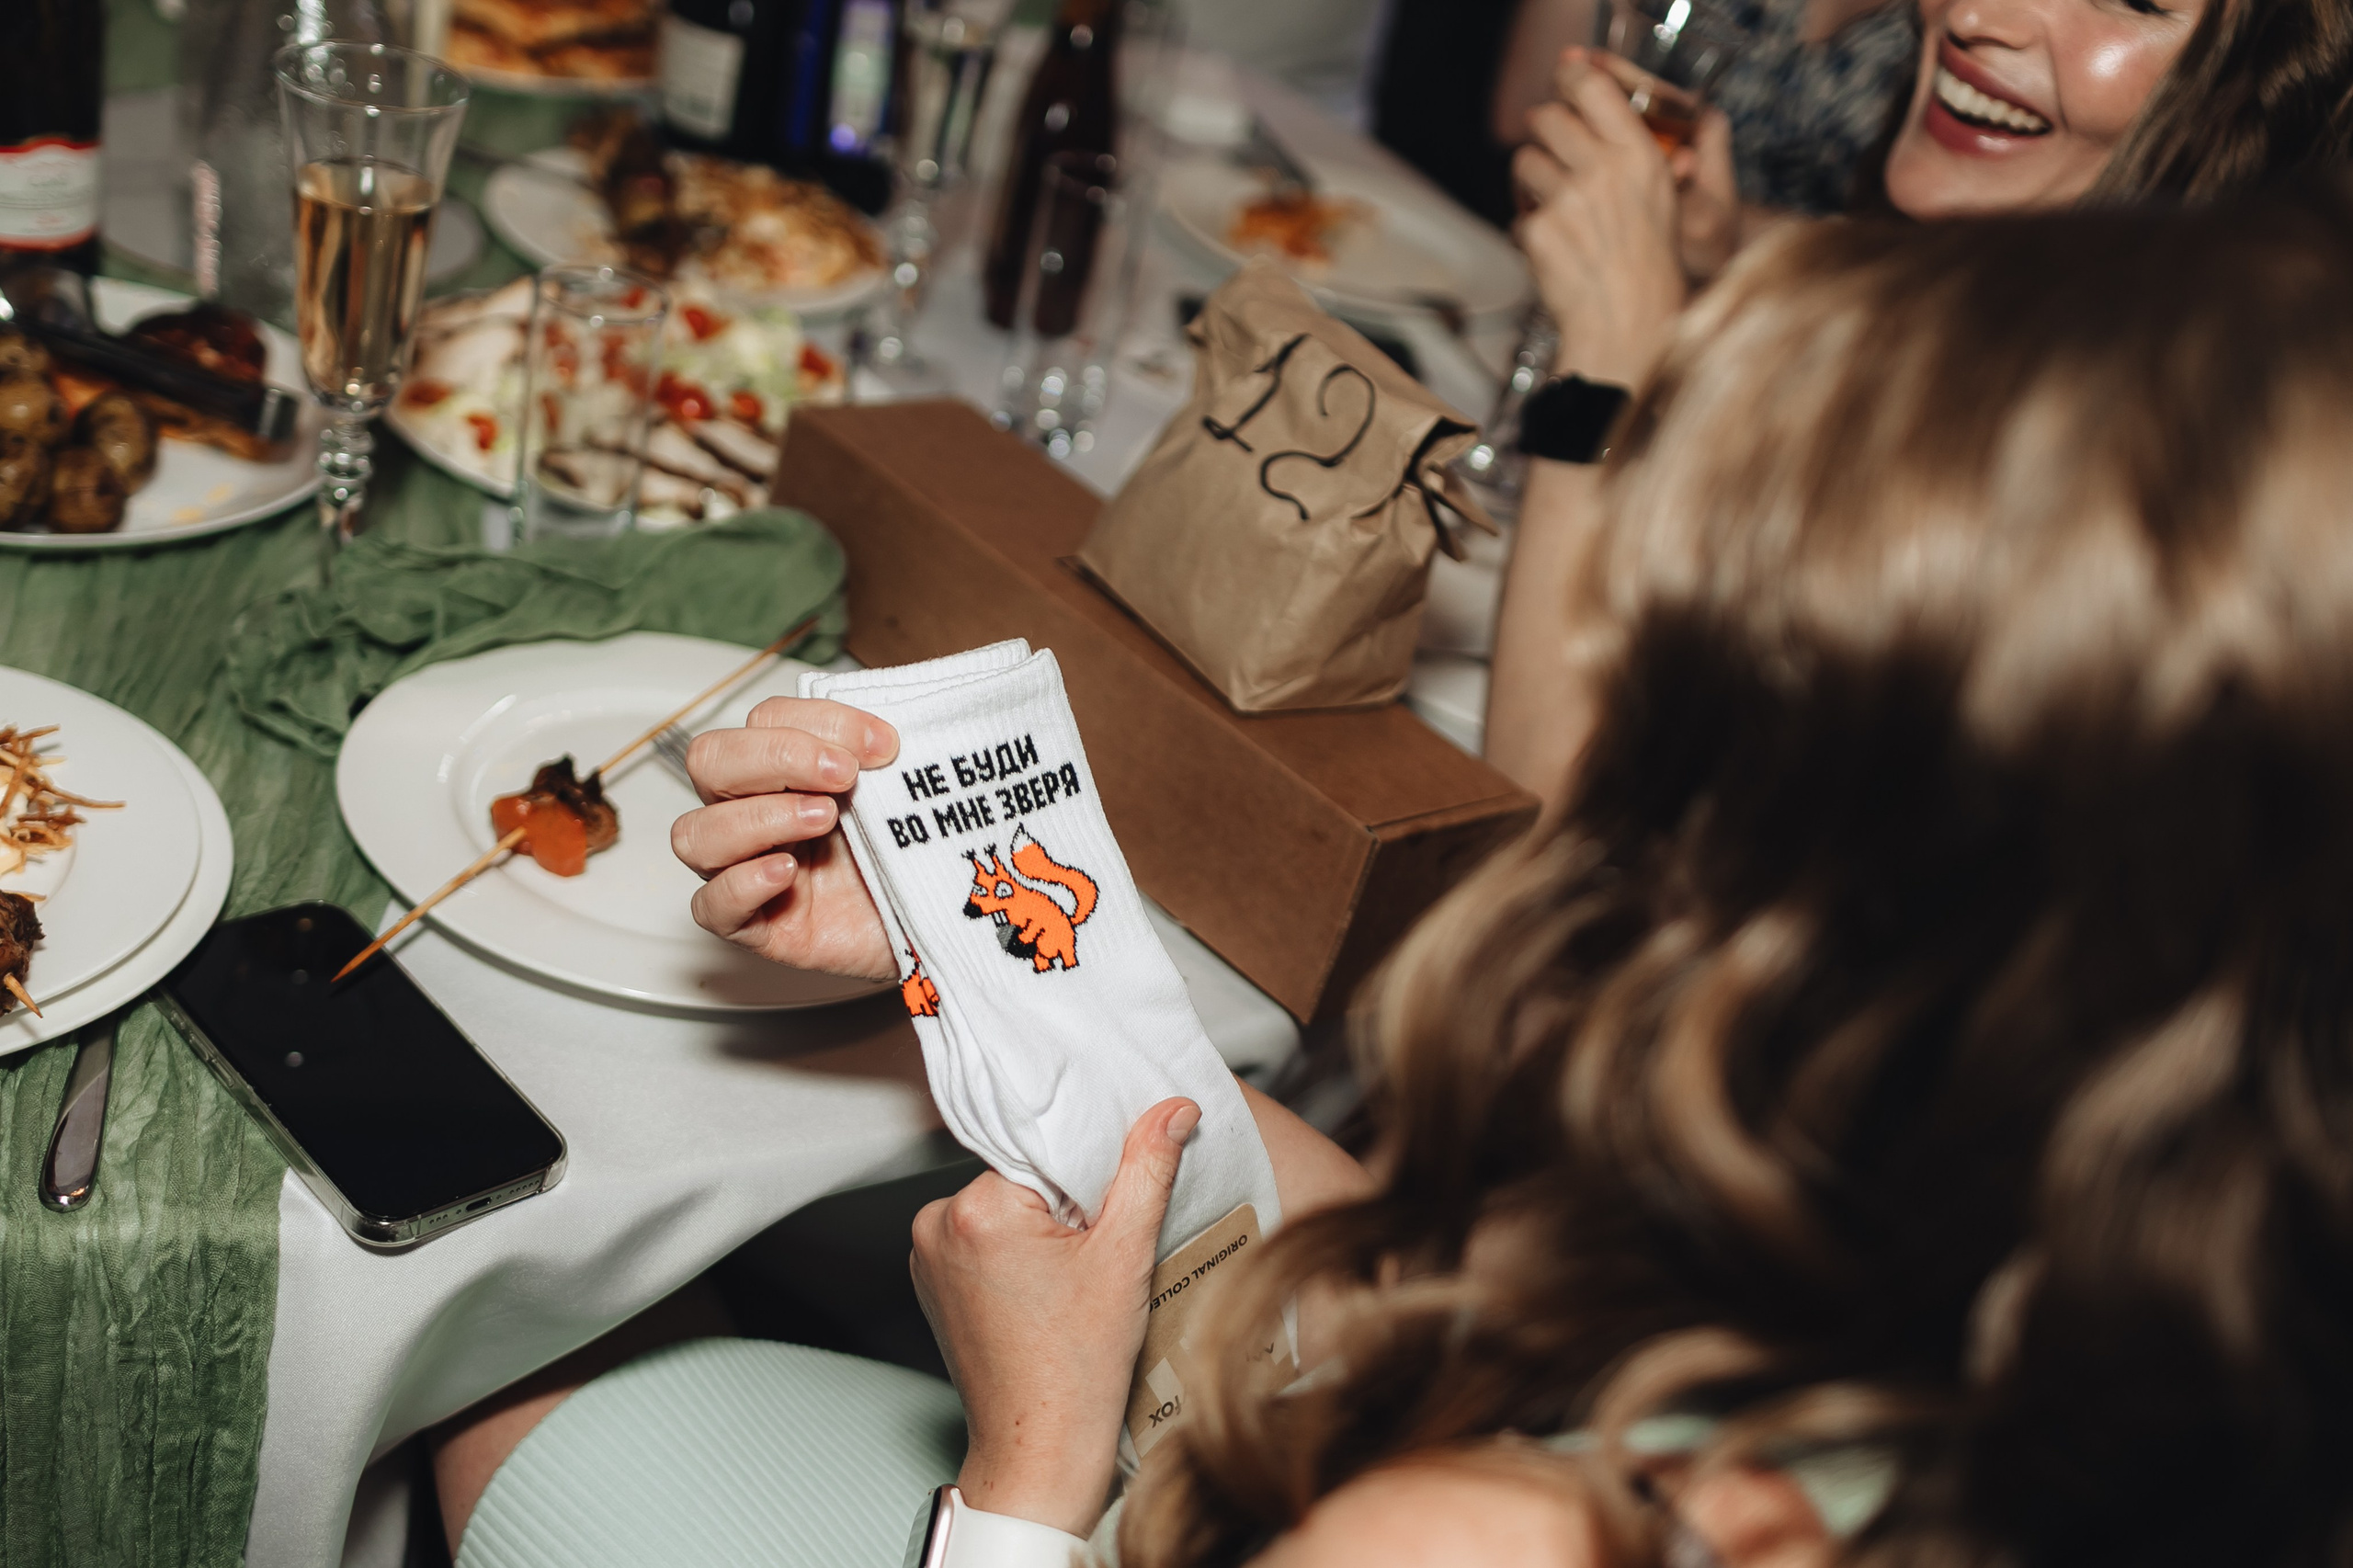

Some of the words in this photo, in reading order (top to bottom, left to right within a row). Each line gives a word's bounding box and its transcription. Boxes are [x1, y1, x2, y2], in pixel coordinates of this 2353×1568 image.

[902, 763, 950, 802] НЕ
[950, 733, 1040, 789] БУДИ
[887, 813, 930, 849] ВО
[932, 794, 995, 838] МНЕ
[995, 761, 1081, 821] ЗВЕРЯ
[1191, 1234, 1248, 1279] ORIGINAL
